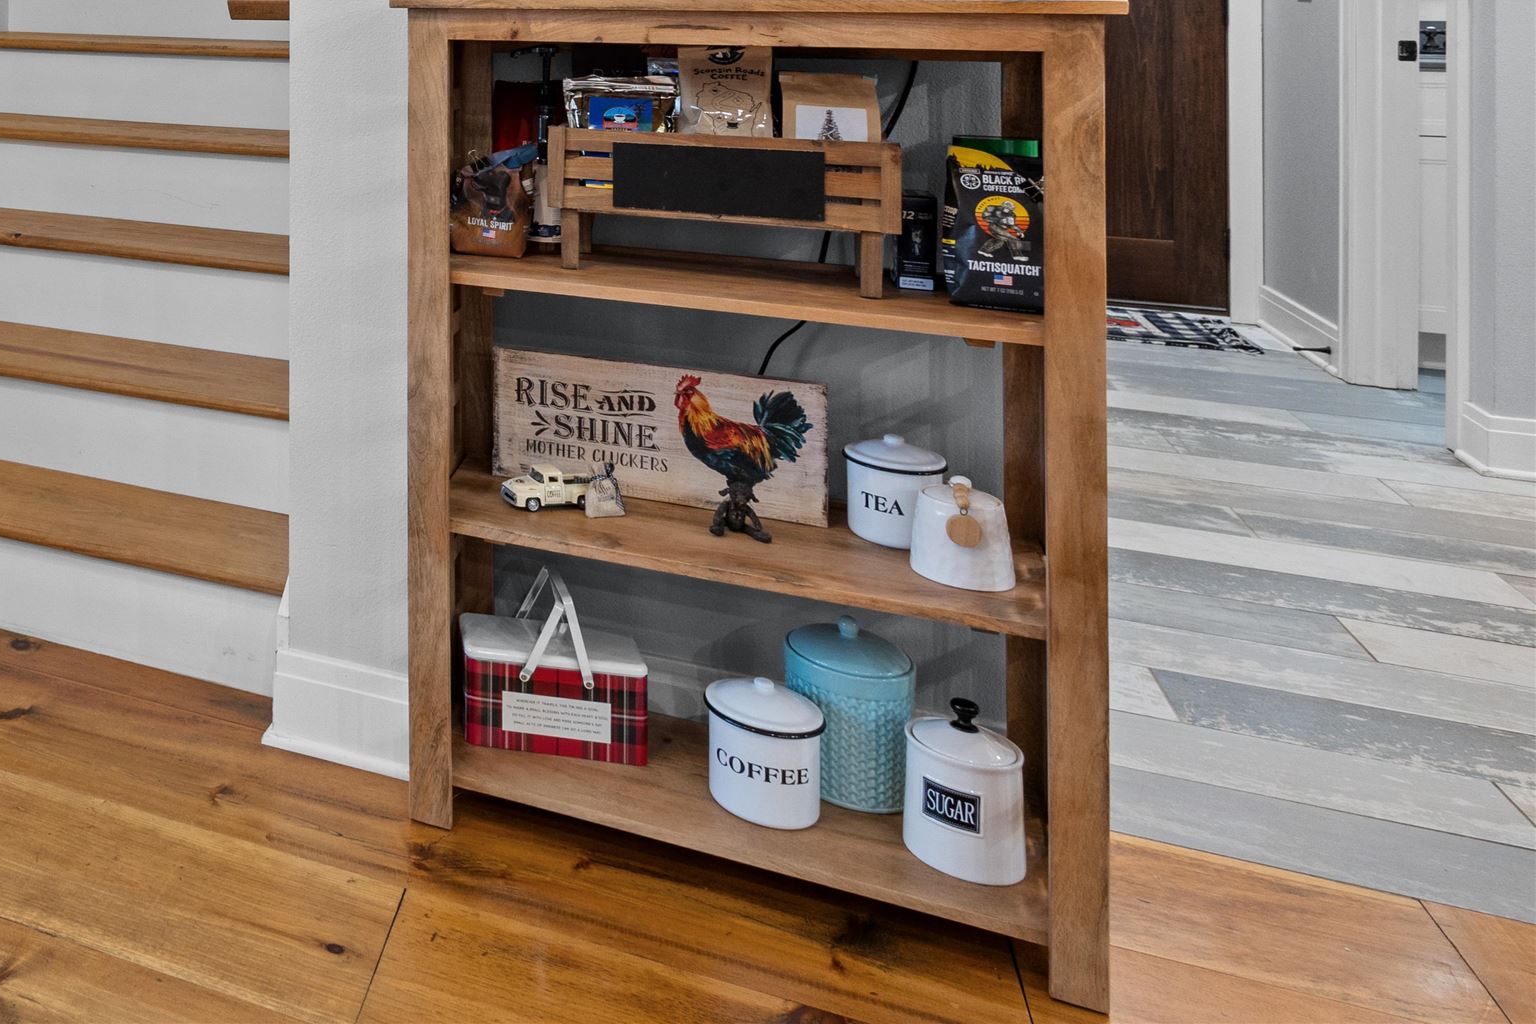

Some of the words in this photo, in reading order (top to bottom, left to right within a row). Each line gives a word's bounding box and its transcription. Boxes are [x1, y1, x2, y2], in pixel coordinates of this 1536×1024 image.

[982, 174, 1013, 185] BLACK
[983, 185, 1007, 193] COFFEE
[467, 216, 488, 227] LOYAL
[489, 220, 513, 231] SPIRIT
[514, 376, 594, 412] RISE
[595, 394, 657, 412] AND
[553, 413, 661, 452] SHINE
[526, 438, 586, 461] MOTHER
[860, 490, 905, 517] TEA
[716, 747, 810, 786] COFFEE
[926, 787, 976, 826] SUGAR
